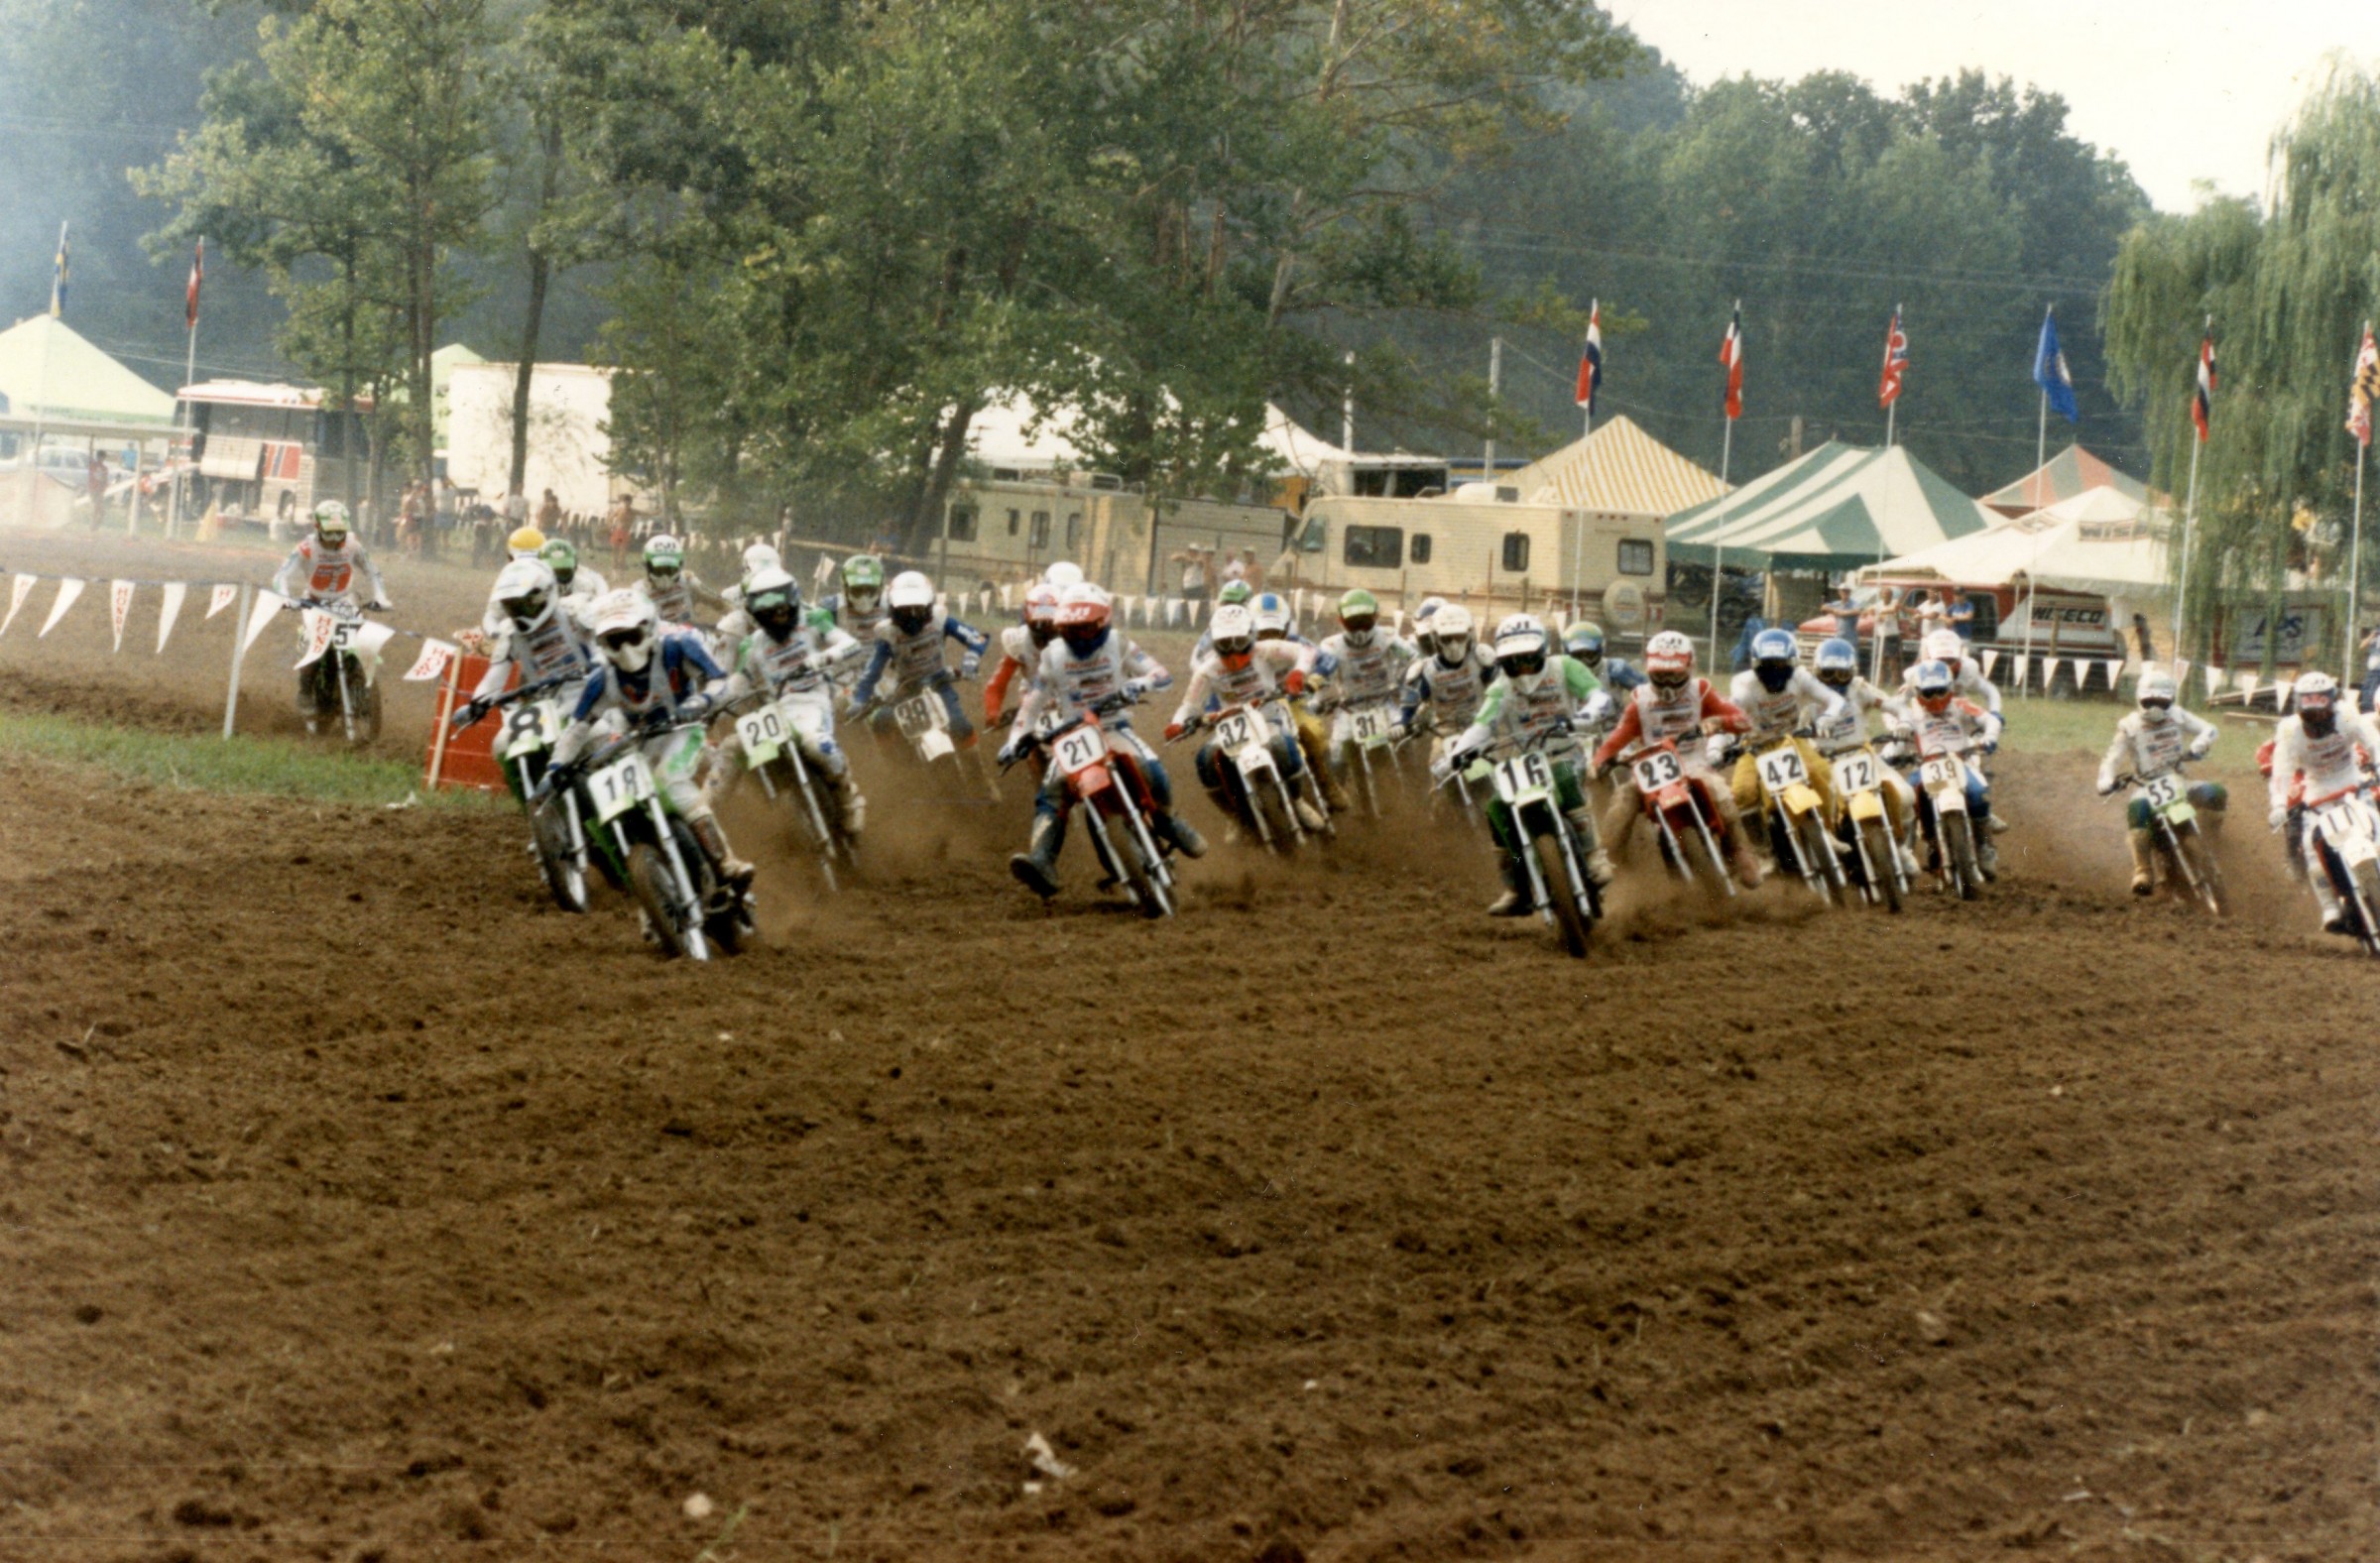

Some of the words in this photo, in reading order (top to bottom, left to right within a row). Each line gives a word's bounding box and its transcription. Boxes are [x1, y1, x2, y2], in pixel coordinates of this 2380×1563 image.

[2032, 606, 2105, 623] WIECO
[510, 705, 543, 743] 8
[747, 713, 779, 747] 20
[1220, 715, 1250, 749] 32
[1356, 714, 1376, 739] 31
[1063, 735, 1093, 766] 21
[605, 765, 639, 800] 18
[1501, 753, 1547, 793] 16
[1639, 754, 1681, 787] 23
[1766, 754, 1801, 784] 42
[1844, 761, 1870, 790] 12
[1929, 760, 1957, 782] 39
[2148, 779, 2176, 806] 55
